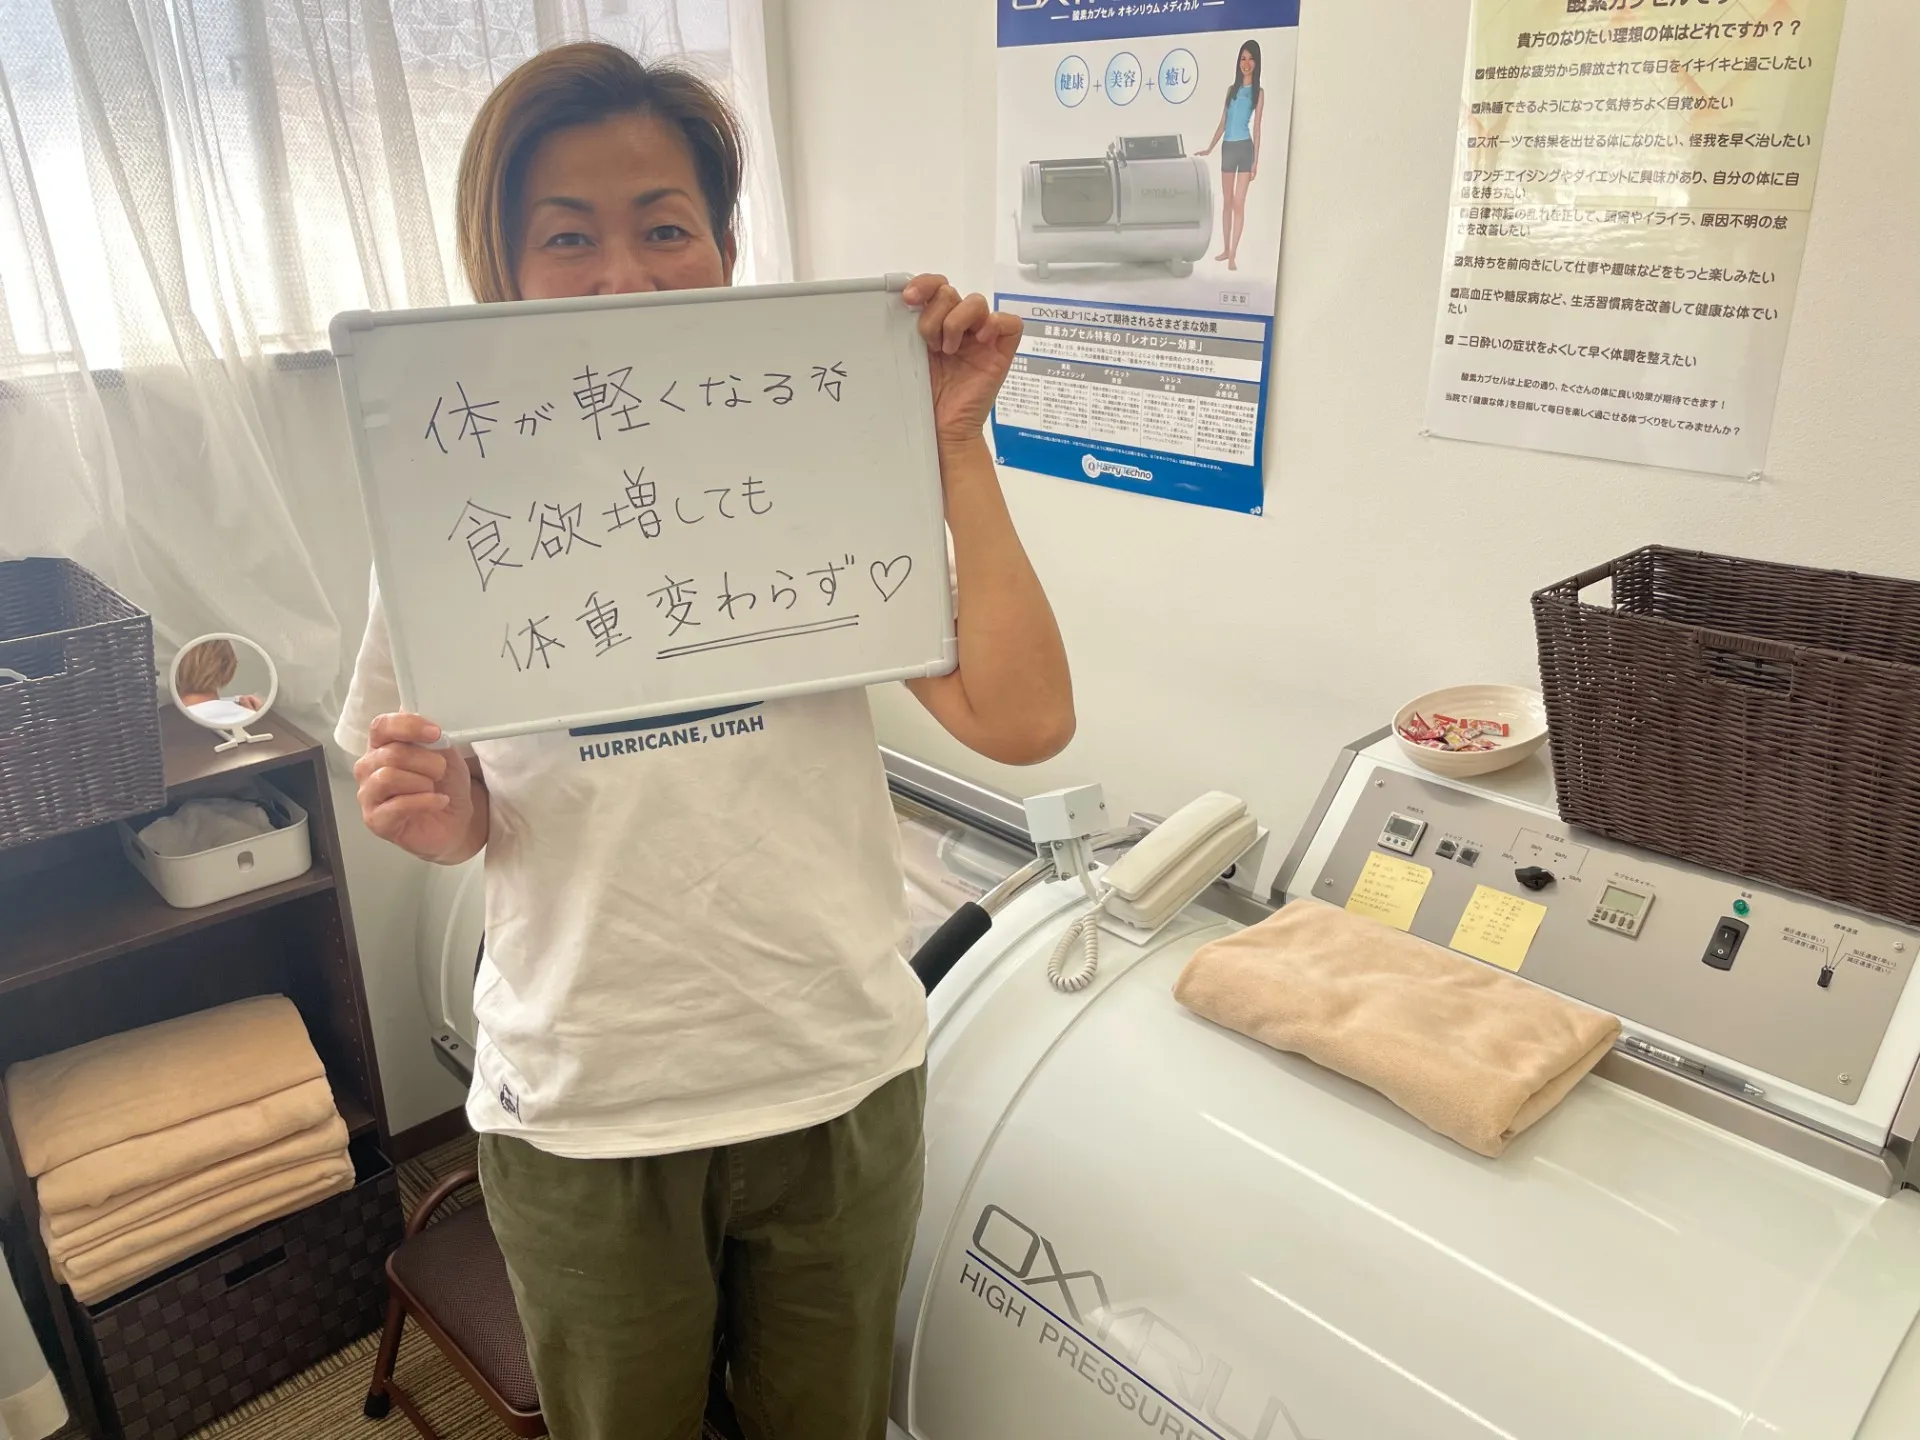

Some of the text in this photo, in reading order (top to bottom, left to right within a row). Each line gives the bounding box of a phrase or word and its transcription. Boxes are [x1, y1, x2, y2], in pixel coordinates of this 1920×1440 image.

[1072, 7, 1114, 21] 酸素カプセル
[1117, 4, 1160, 17] オキシリウム
[1162, 0, 1199, 12] メディカル
[1165, 67, 1192, 86] 癒し
[1485, 56, 1812, 80] 慢性的な疲労から解放されて毎日をイキイキと過ごしたい
[1060, 72, 1084, 91] 健康
[1110, 69, 1136, 88] 美容
[1480, 96, 1733, 115] 熟睡できるようになって気持ちよく目覚めたい
[1477, 132, 1811, 149] スポーツで結果を出せる体になりたい、怪我を早く治したい
[1472, 170, 1799, 187] アンチエイジングやダイエットに興味があり、自分の体に自
[1461, 186, 1526, 200] 信を持ちたい
[1468, 207, 1788, 230] 自律神経の乱れを正して、頭痛やイライラ、原因不明の怠
[1457, 223, 1531, 237] さを改善したい
[1463, 256, 1775, 284] 気持ちを前向きにして仕事や趣味などをもっと楽しみたい
[1223, 294, 1246, 304] 日本製
[1459, 287, 1778, 320] 高血圧や糖尿病など、生活習慣病を改善して健康な体でい
[1447, 304, 1467, 315] たい
[1044, 325, 1204, 352] 酸素カプセル特有の「レオロジー効果」
[1457, 335, 1696, 368] 二日酔いの症状をよくして早く体調を整えたい
[1104, 369, 1130, 378] ダイエット
[1160, 375, 1182, 384] ストレス
[1219, 382, 1237, 390] ケガの
[448, 467, 773, 592] 食欲増しても
[501, 554, 857, 672] 体重変わらず
[579, 715, 764, 762] HURRICANE, UTAH
[959, 1263, 1027, 1328] HIGH
